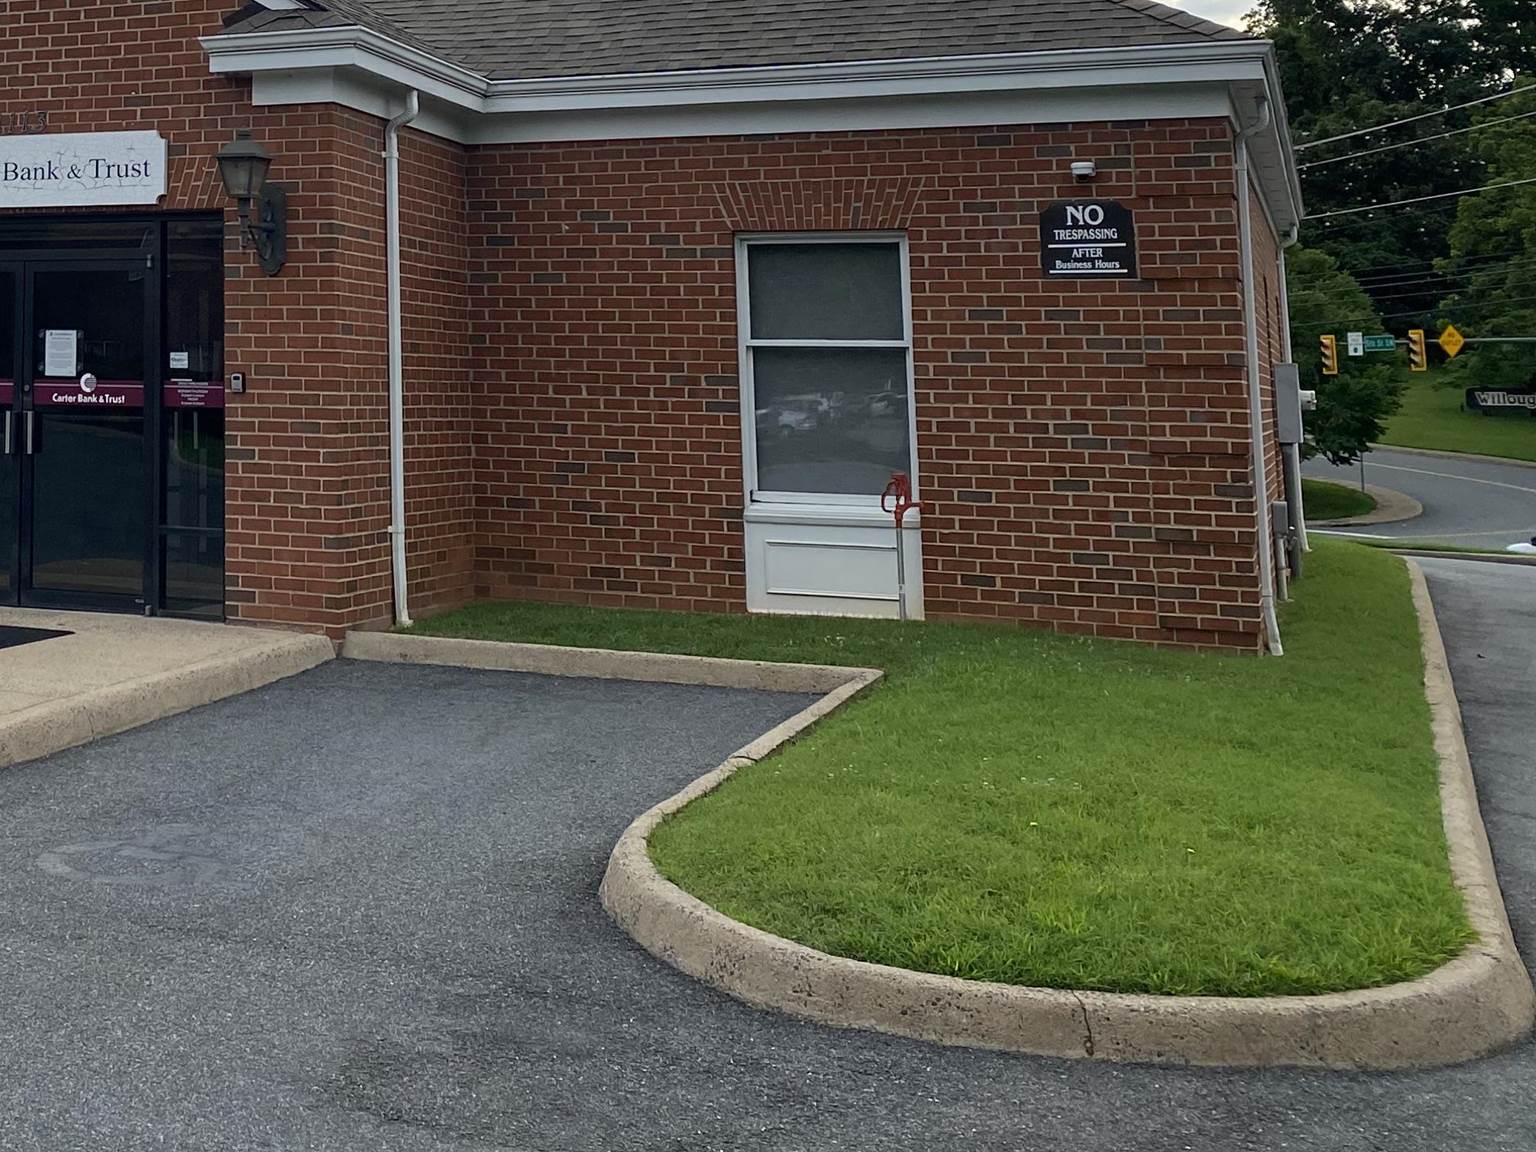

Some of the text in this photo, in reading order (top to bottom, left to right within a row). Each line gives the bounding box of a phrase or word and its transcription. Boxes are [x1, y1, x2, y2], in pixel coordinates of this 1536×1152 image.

[2, 160, 60, 181] Bank
[67, 162, 82, 179] &
[88, 157, 151, 179] Trust
[1065, 204, 1104, 226] NO
[1053, 228, 1118, 241] TRESPASSING
[1071, 248, 1104, 258] AFTER
[1055, 259, 1120, 270] Business Hours
[52, 393, 125, 404] Carter Bank & Trust
